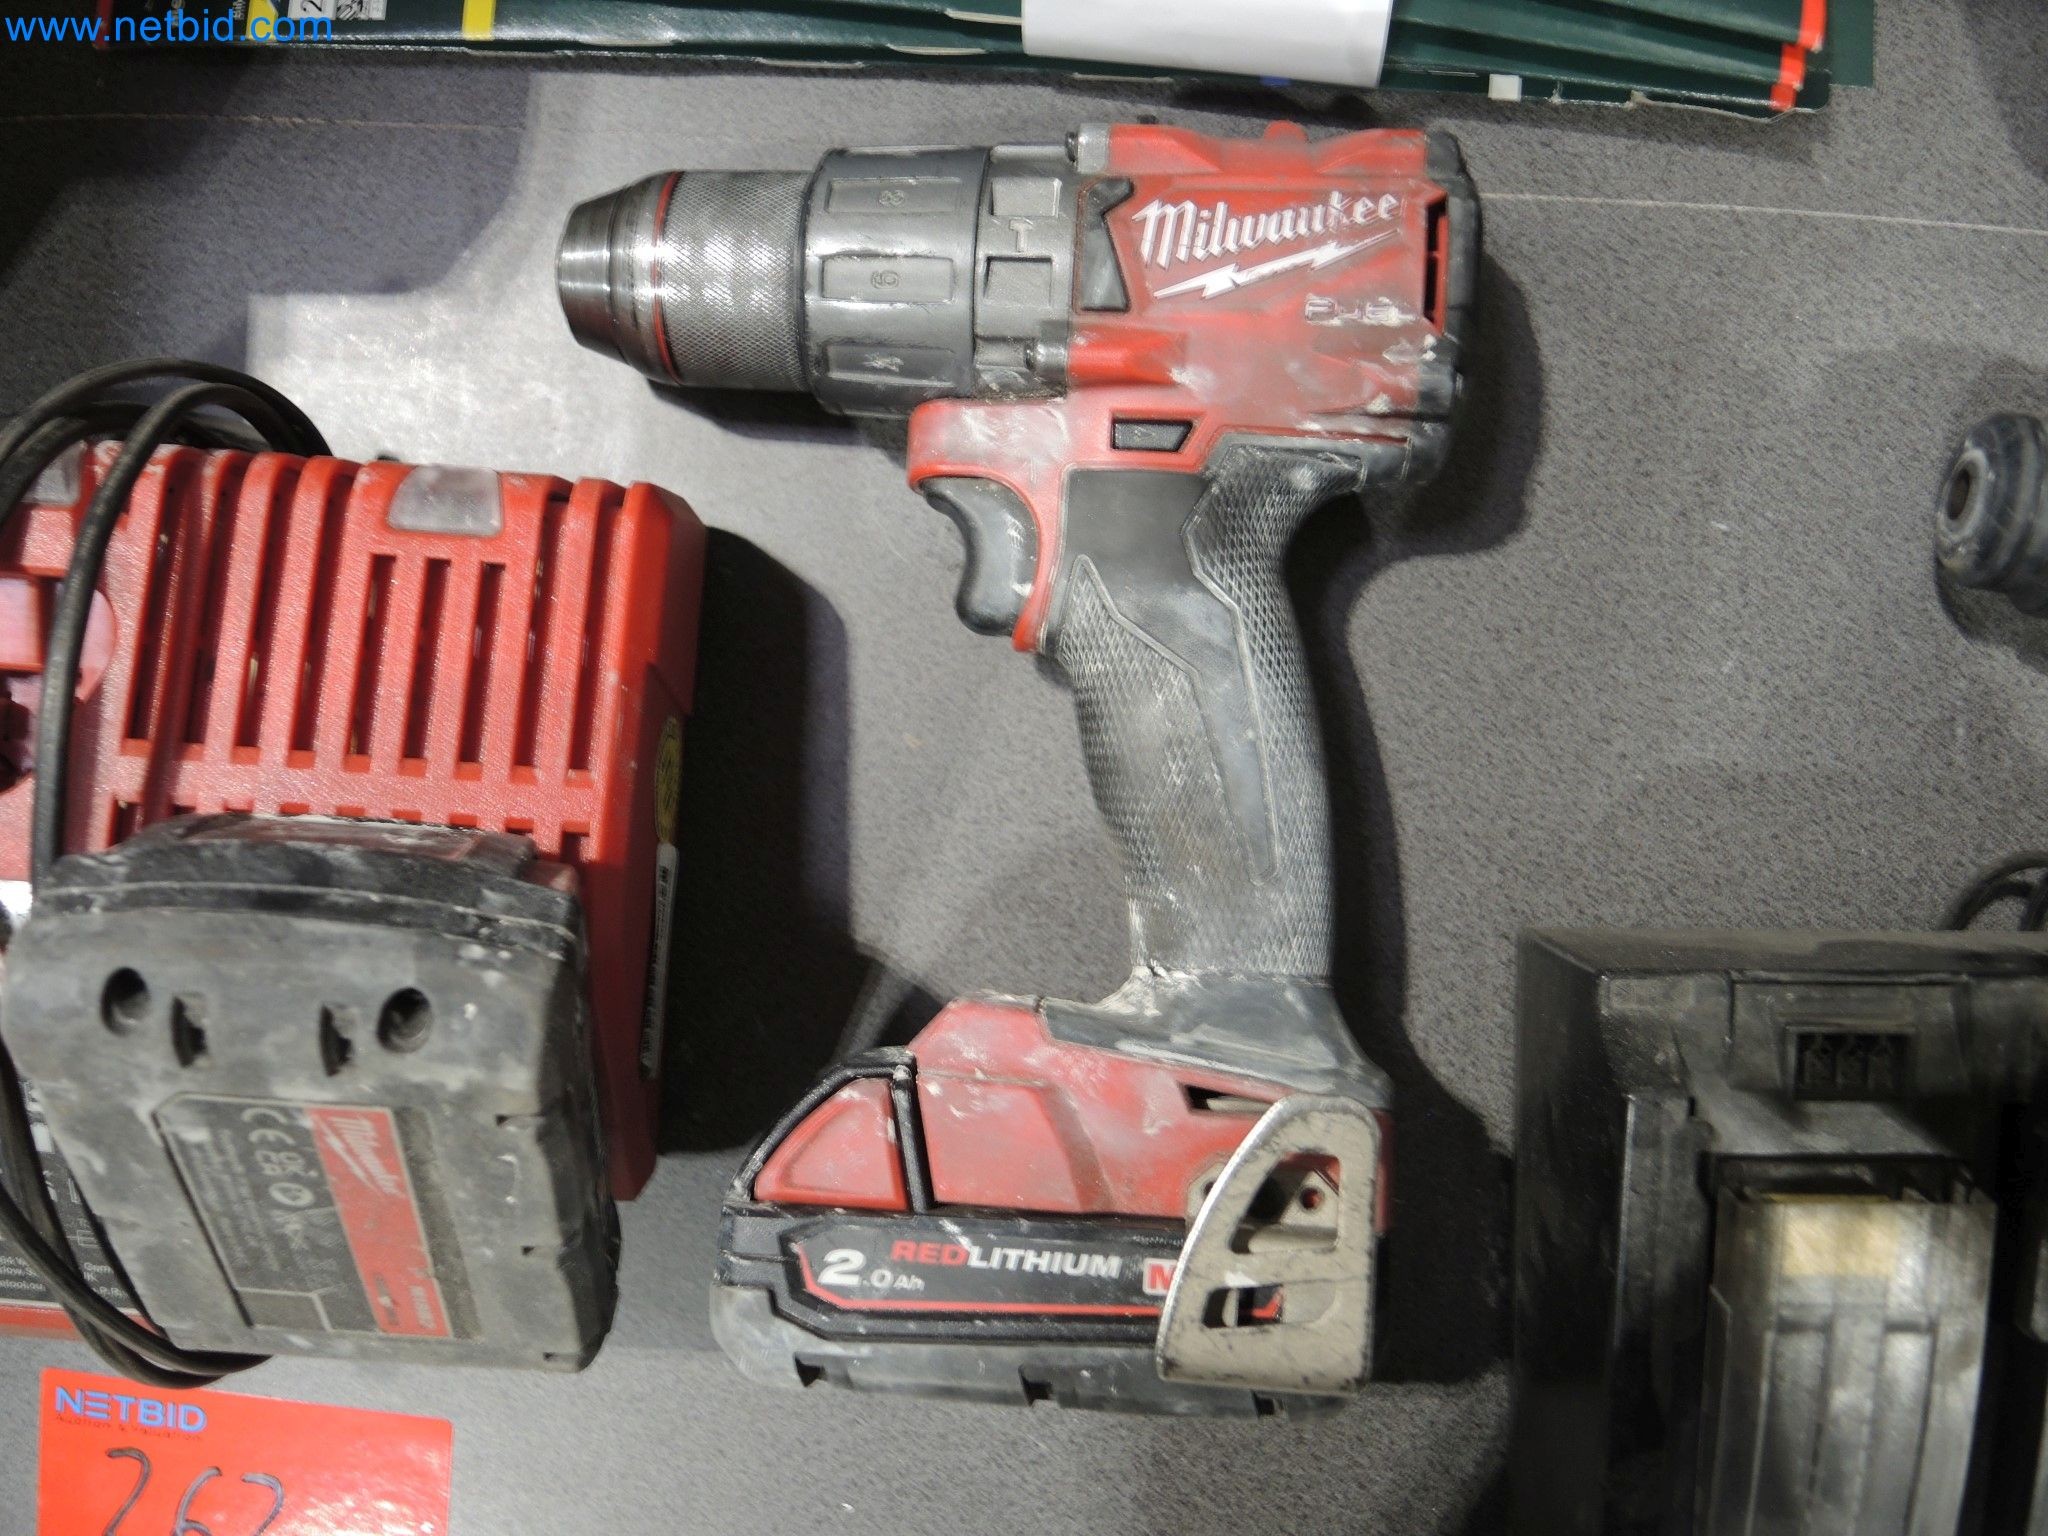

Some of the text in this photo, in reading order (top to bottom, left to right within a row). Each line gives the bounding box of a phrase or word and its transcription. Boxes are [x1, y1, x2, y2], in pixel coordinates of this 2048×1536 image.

[1132, 190, 1400, 270] Milwaukee
[891, 1239, 1122, 1280] REDLITHIUM
[55, 1386, 208, 1433] NETBID
